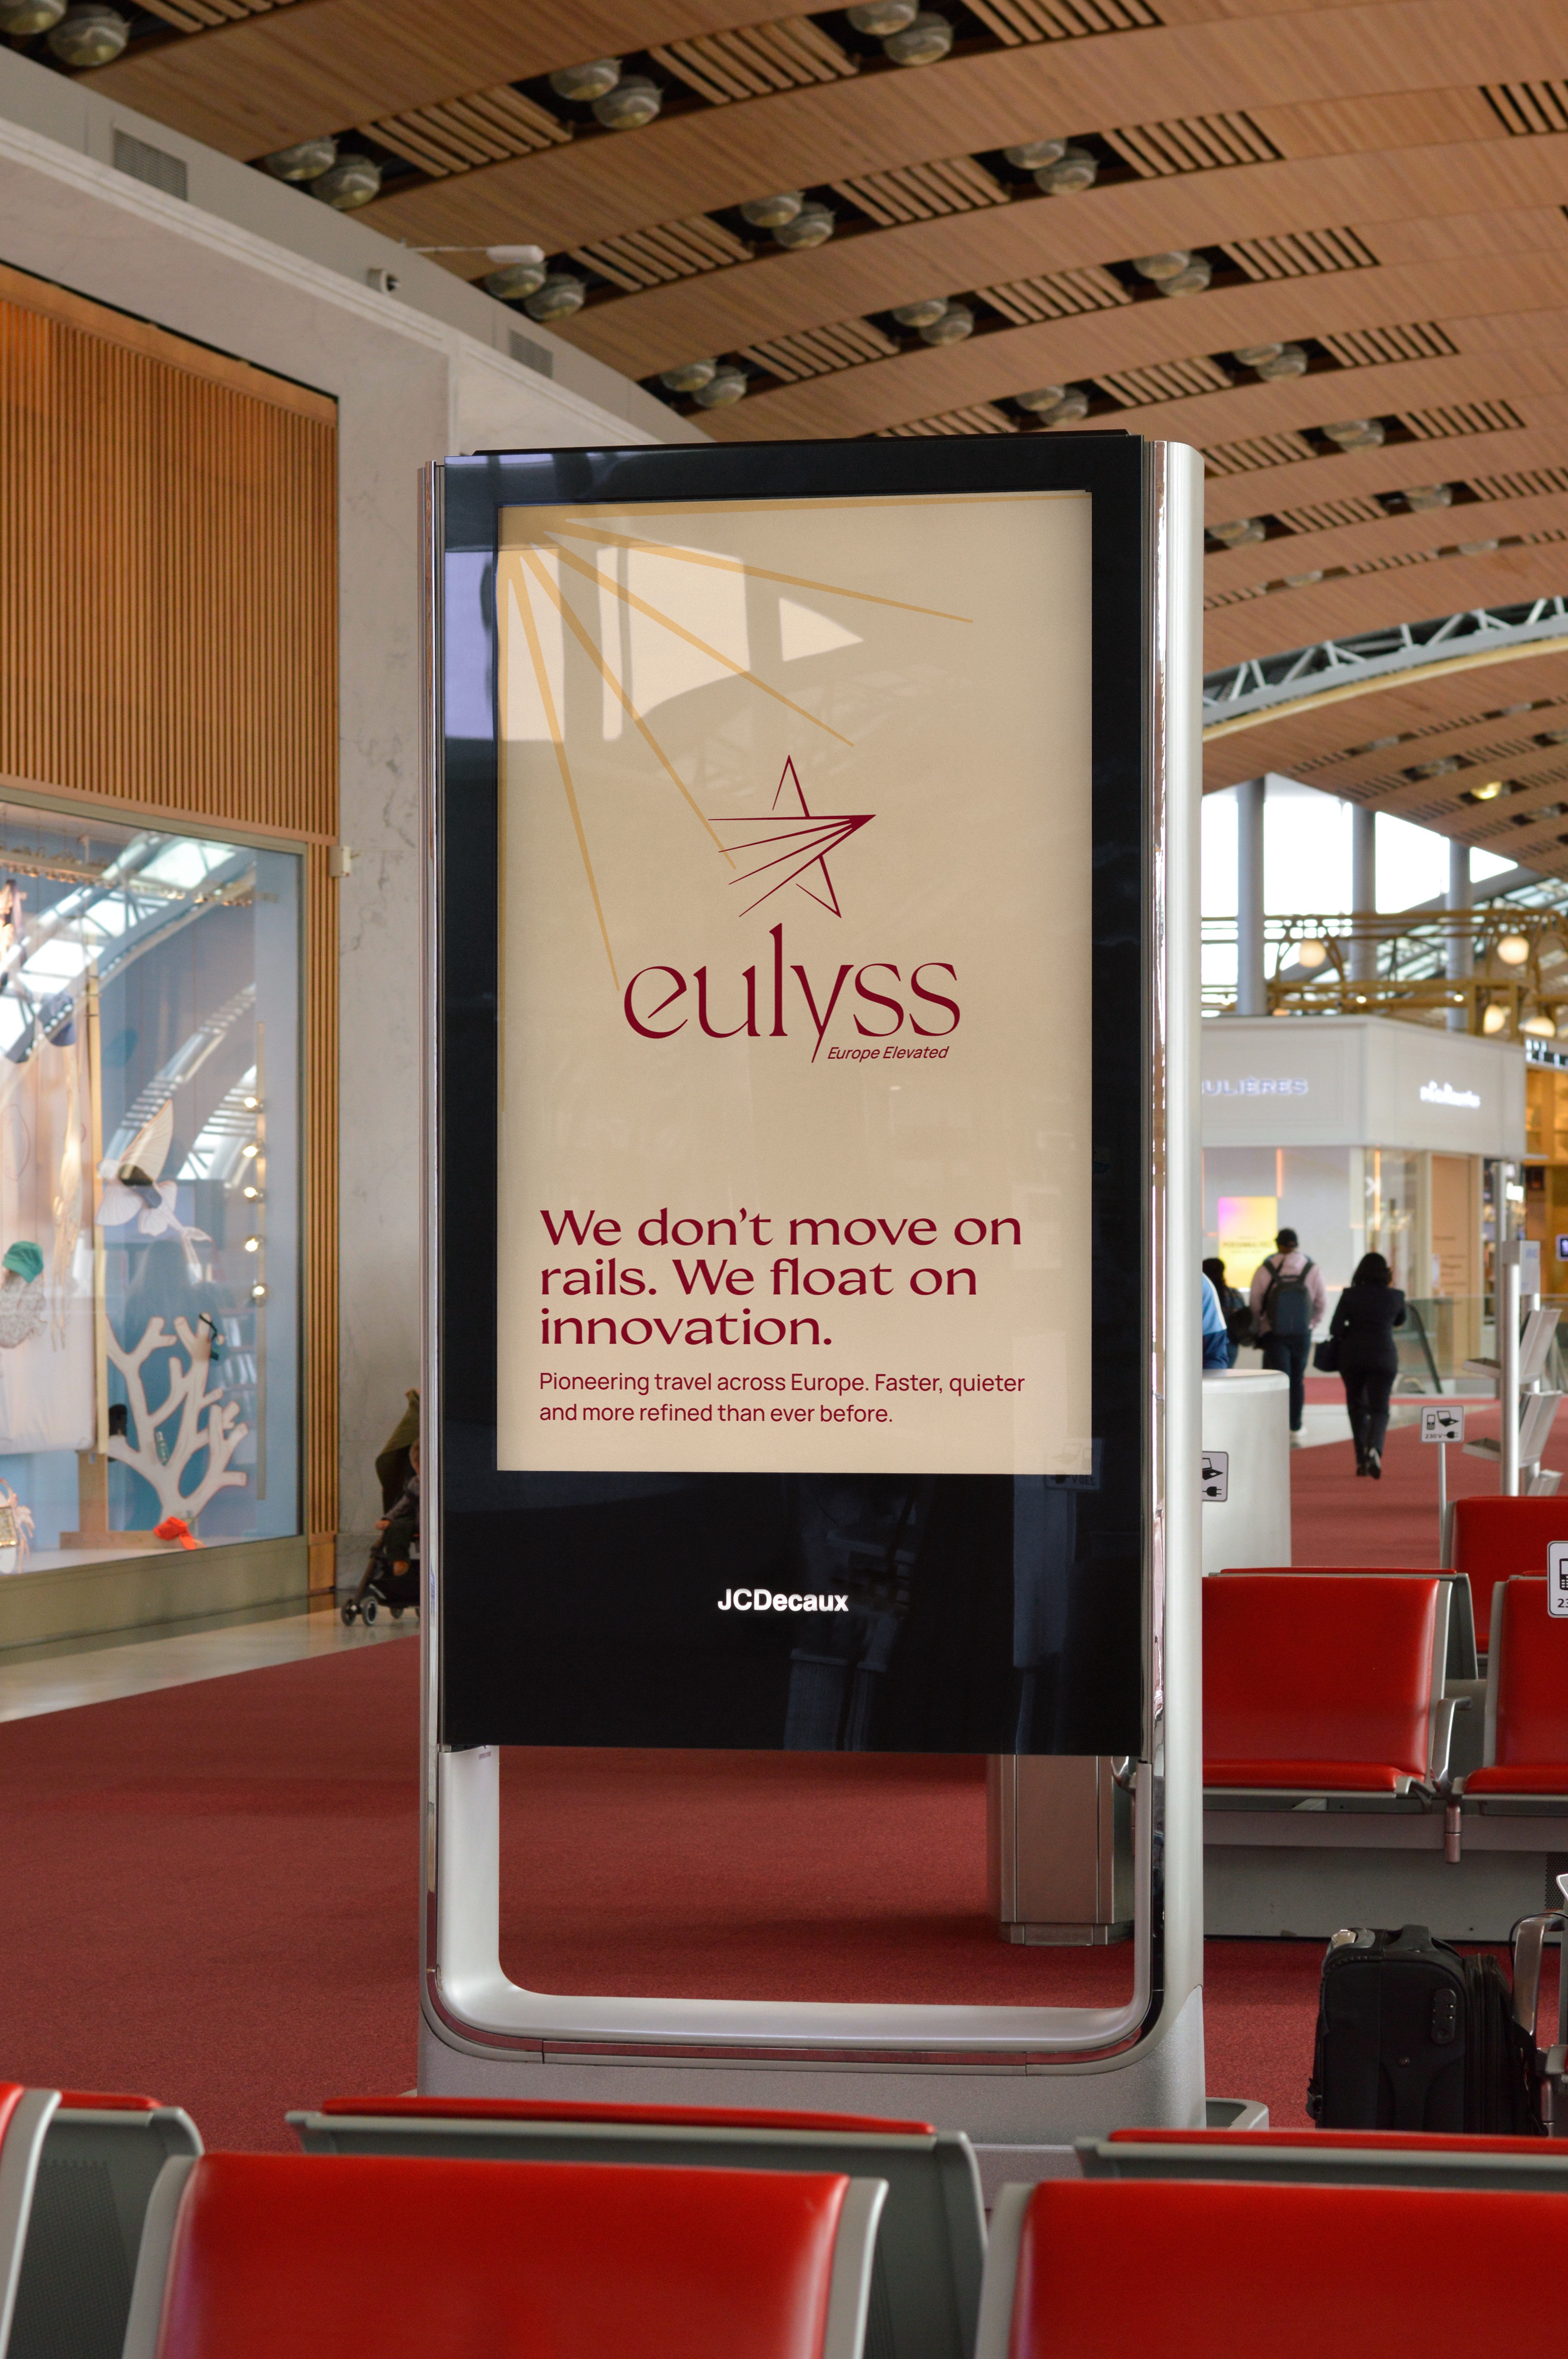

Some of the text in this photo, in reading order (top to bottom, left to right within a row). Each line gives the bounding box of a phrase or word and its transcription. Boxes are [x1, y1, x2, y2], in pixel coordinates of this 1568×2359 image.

[624, 923, 961, 1063] eulyss
[827, 1046, 950, 1063] Europe Elevated
[1202, 1076, 1308, 1096] ULIÈRES
[540, 1207, 1022, 1247] We don’t move on
[541, 1258, 977, 1296] rails. We float on
[541, 1308, 833, 1346] innovation.
[540, 1372, 1025, 1397] Pioneering travel across Europe. Faster, quieter
[540, 1403, 893, 1423] and more refined than ever before.
[717, 1588, 849, 1612] JCDecaux
